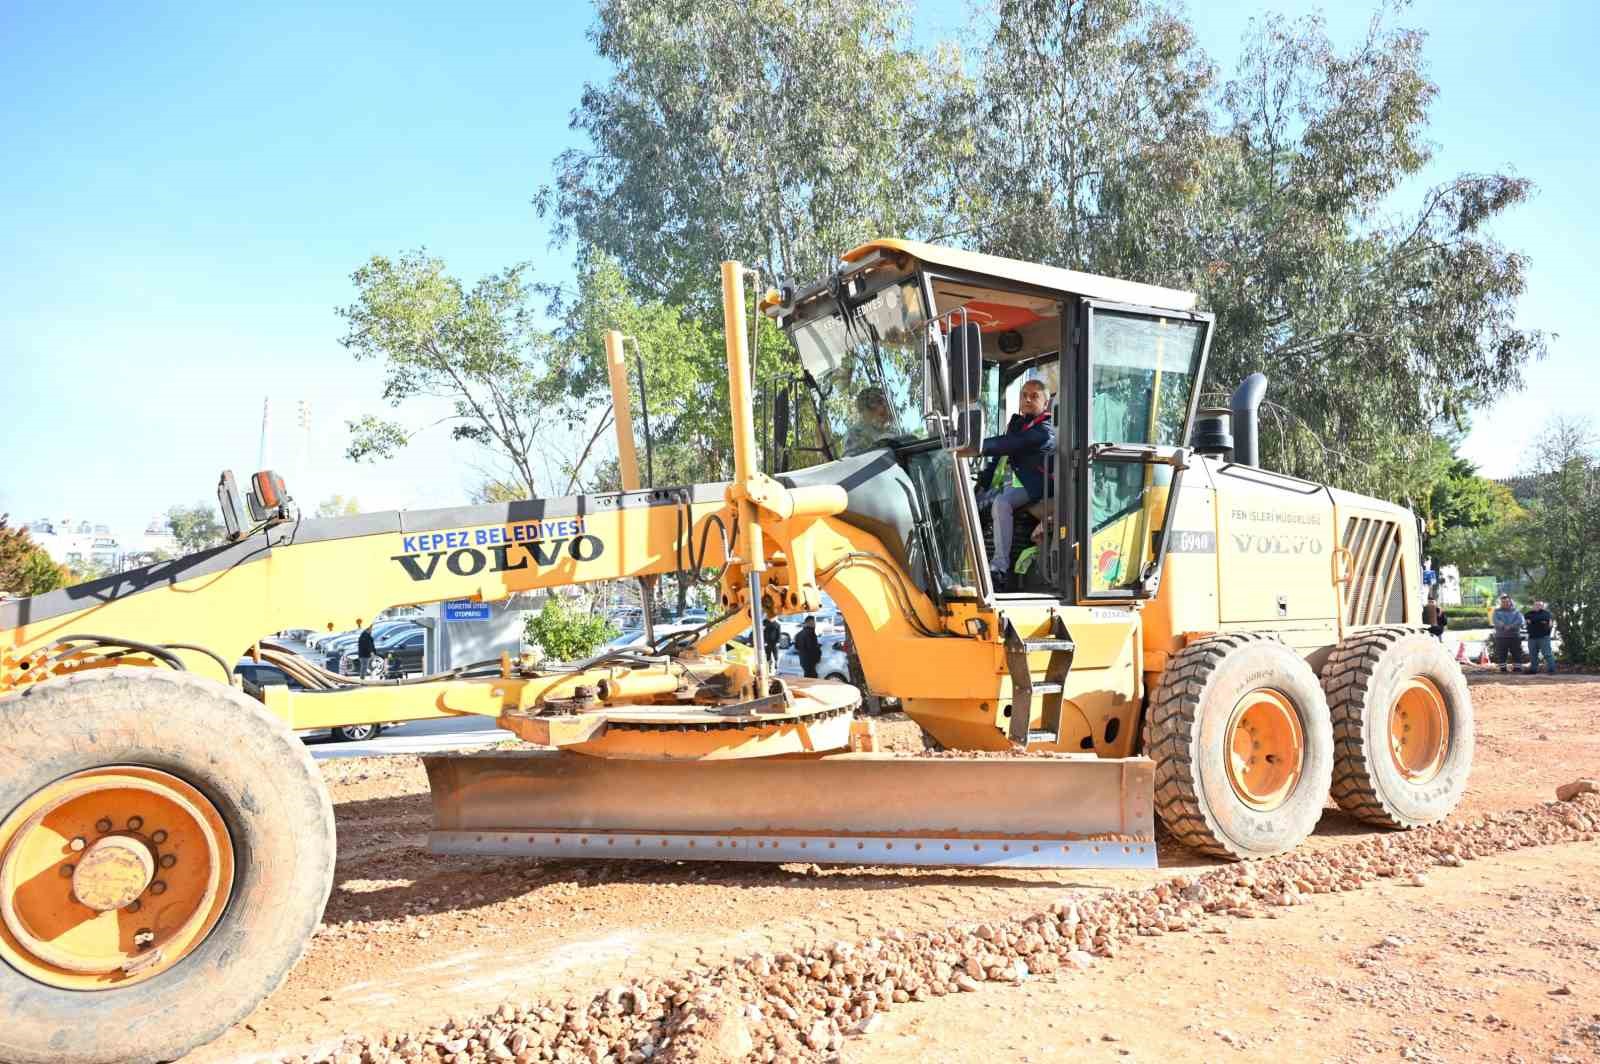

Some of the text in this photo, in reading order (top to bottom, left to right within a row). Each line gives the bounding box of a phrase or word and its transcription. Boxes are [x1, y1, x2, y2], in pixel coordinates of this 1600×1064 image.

[403, 519, 586, 553] KEPEZ BELEDİYESİ
[1232, 533, 1323, 555] VOLVO
[390, 535, 604, 581] VOLVO
